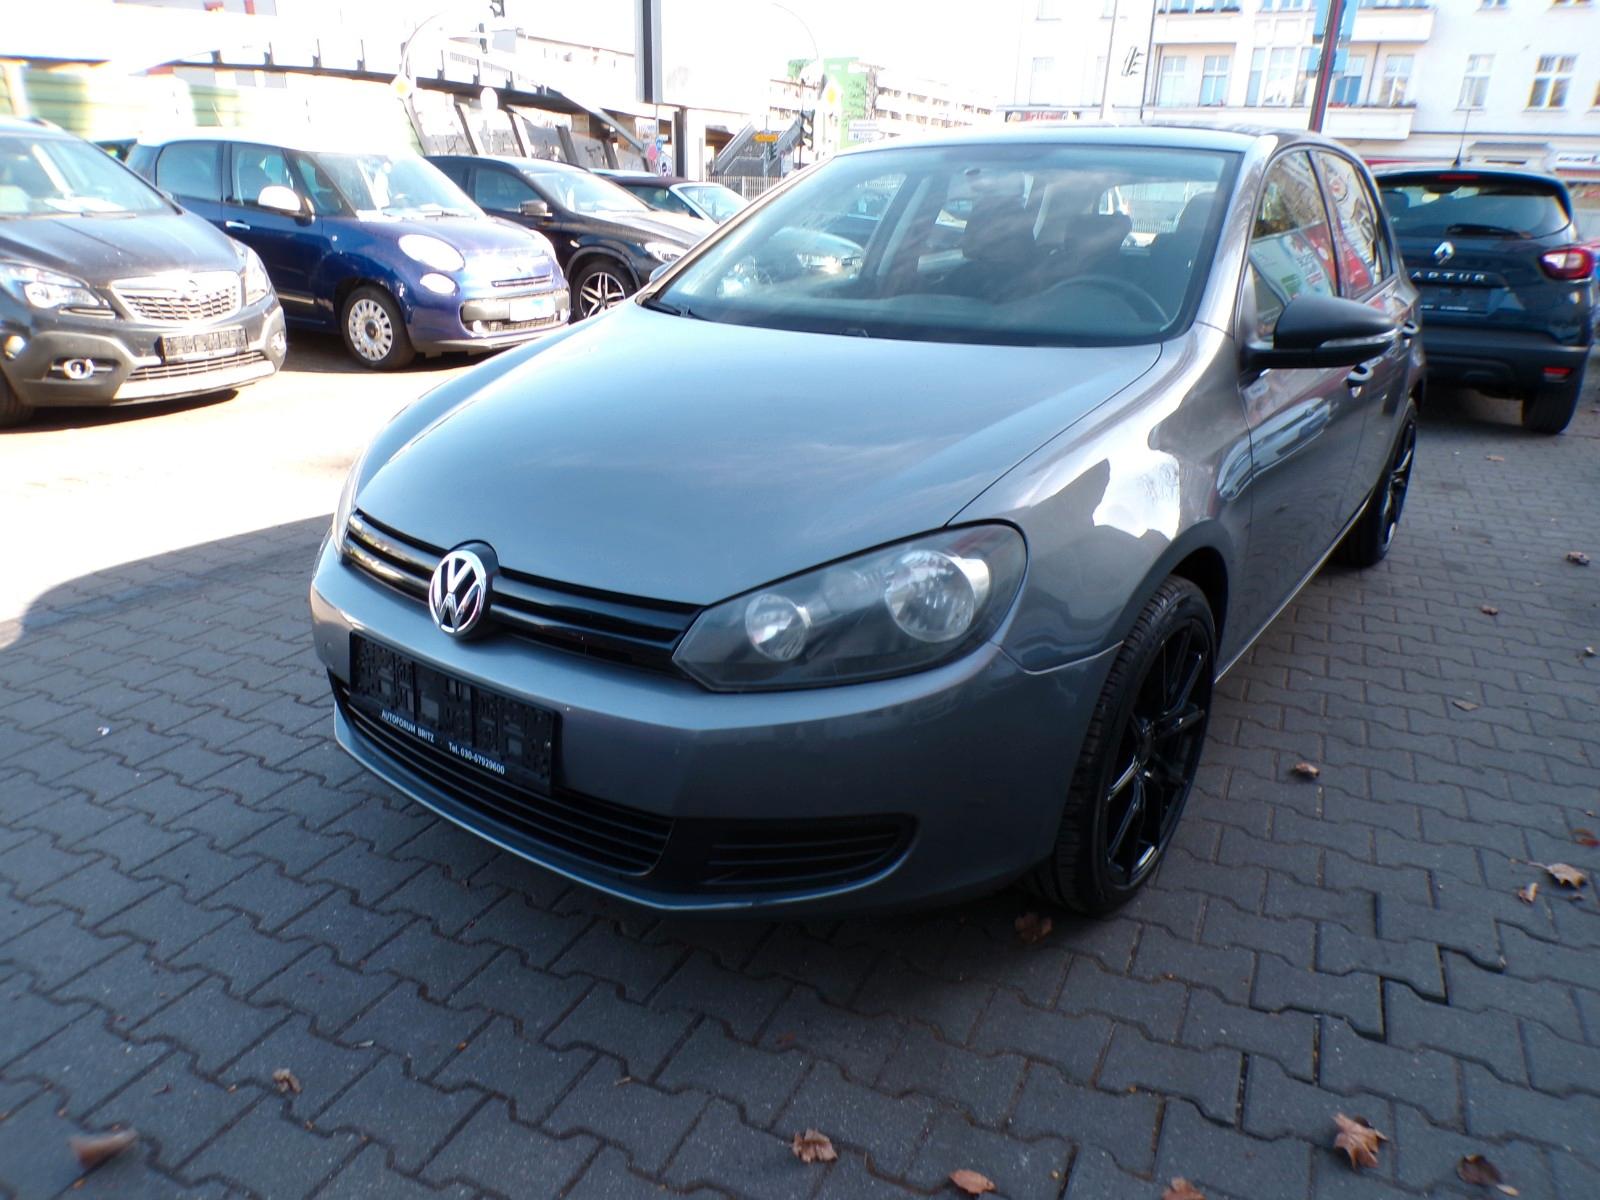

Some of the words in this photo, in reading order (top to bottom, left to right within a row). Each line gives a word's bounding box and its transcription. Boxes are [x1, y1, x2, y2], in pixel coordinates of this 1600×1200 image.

[1411, 271, 1486, 281] APTUR
[381, 709, 416, 734] AUTOFORUM
[417, 727, 435, 743] BRITZ
[448, 741, 460, 755] Tel.
